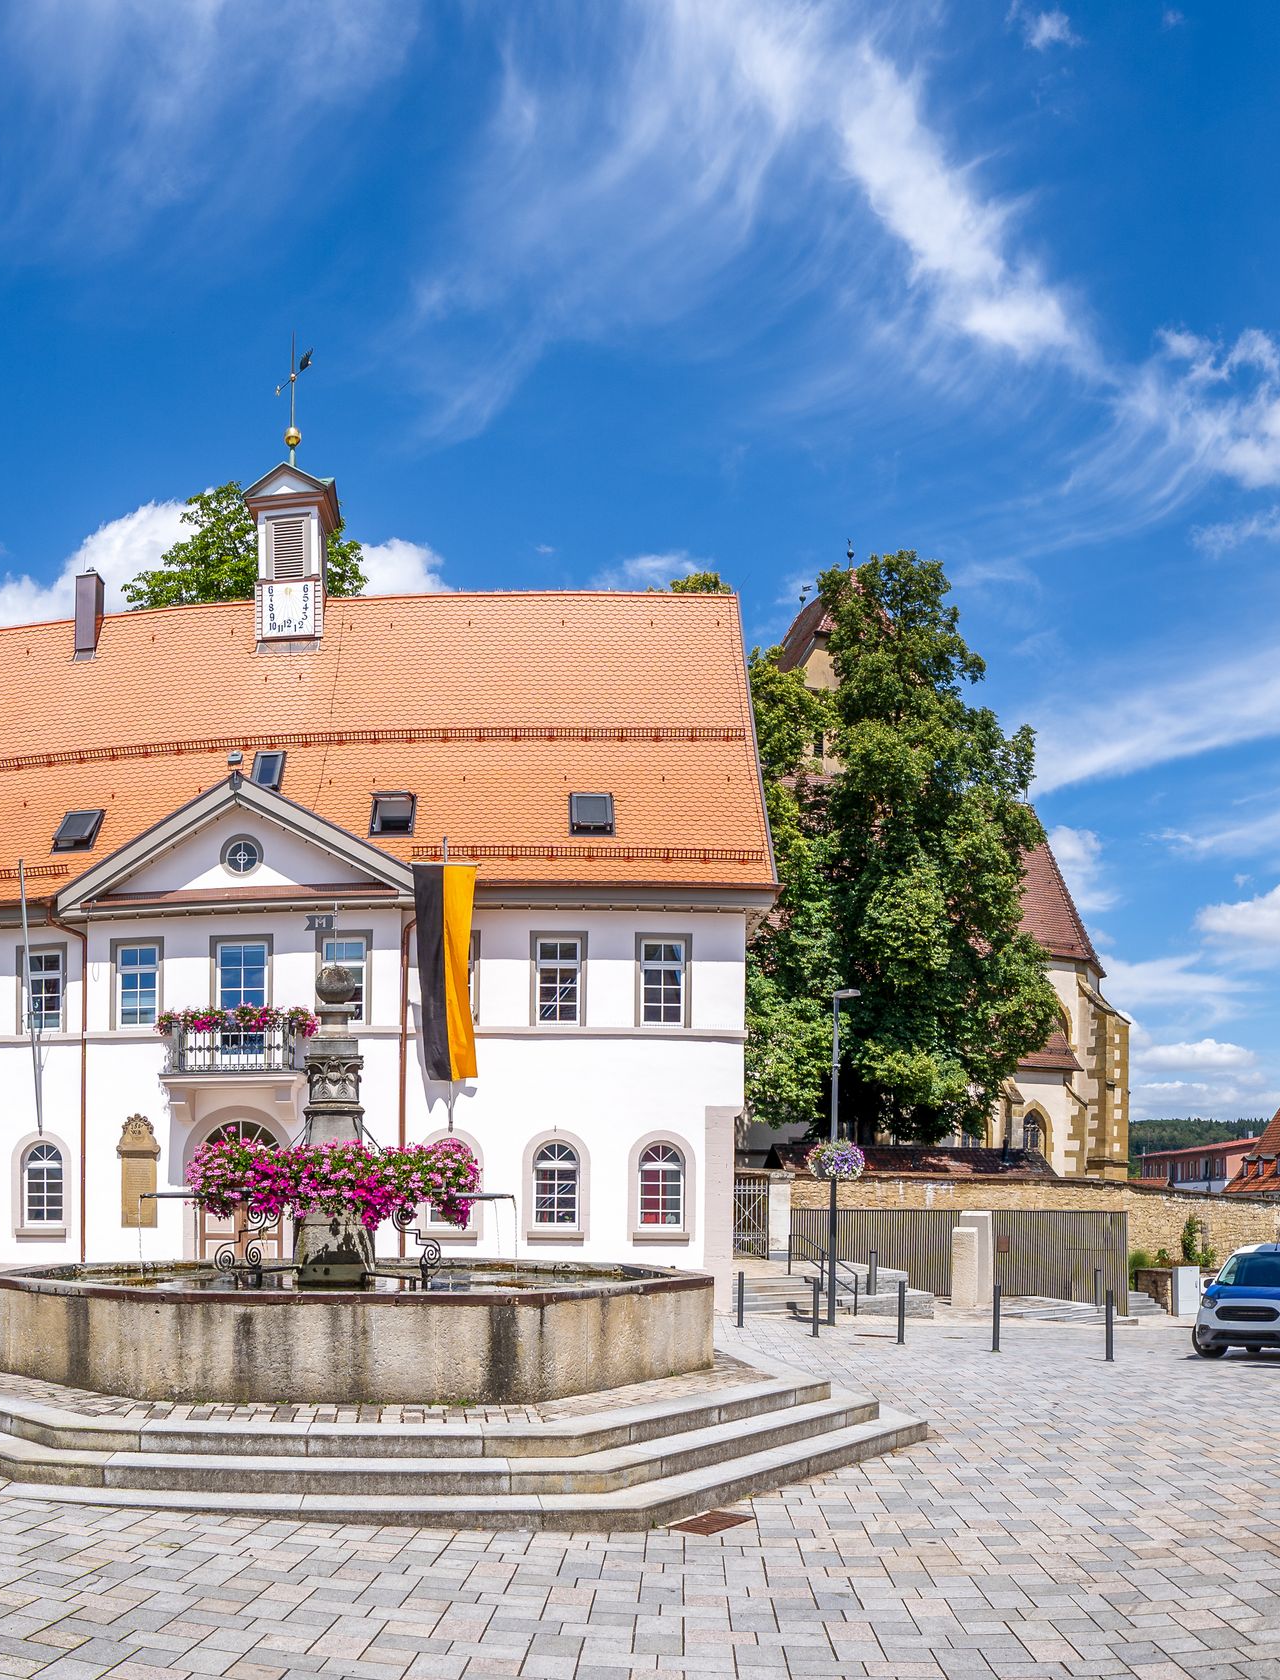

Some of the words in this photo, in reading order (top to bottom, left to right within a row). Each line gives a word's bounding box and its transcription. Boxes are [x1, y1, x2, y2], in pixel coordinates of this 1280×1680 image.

[268, 585, 274, 594] 6
[303, 584, 308, 593] 6
[269, 594, 274, 602] 7
[302, 593, 309, 602] 5
[302, 603, 309, 611] 4
[270, 612, 275, 621] 9
[301, 611, 308, 620] 3
[269, 622, 276, 630] 10
[283, 619, 291, 628] 12
[293, 624, 297, 632] 1
[315, 916, 326, 928] M
